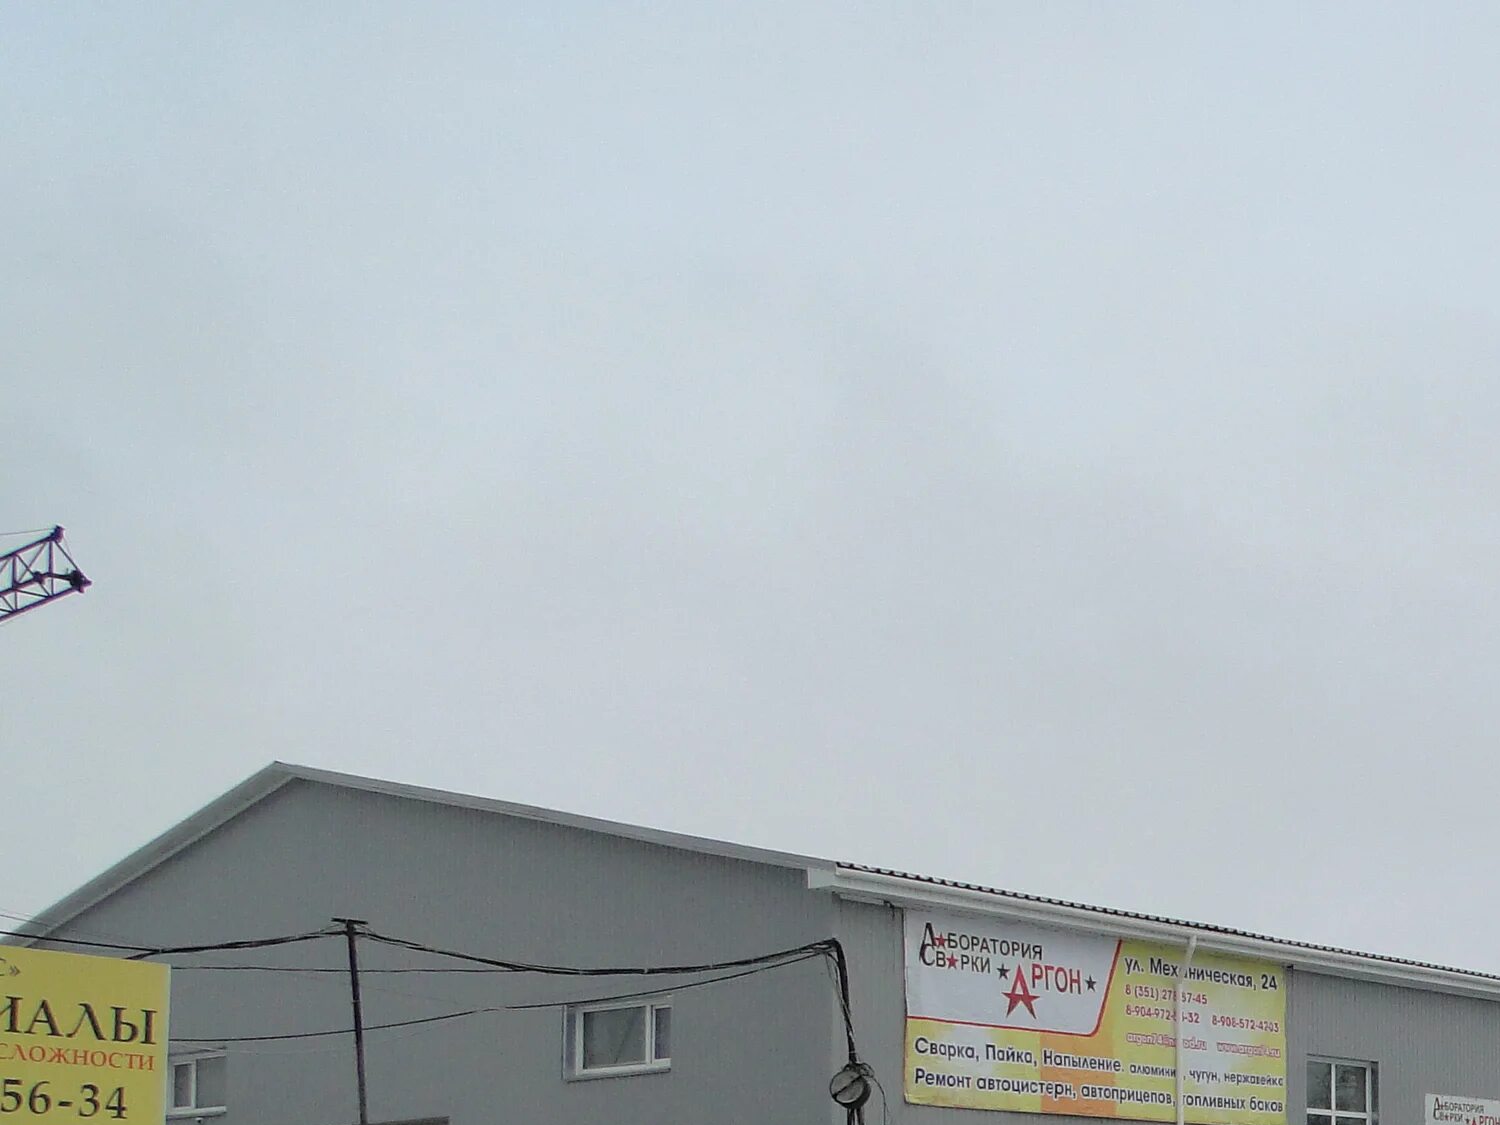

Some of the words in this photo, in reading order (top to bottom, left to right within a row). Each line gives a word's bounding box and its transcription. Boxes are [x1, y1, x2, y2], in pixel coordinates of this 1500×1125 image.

[1002, 963, 1081, 1019] АРГОН
[1125, 957, 1144, 975] ул.
[1150, 958, 1257, 990] Мехническая,
[1261, 974, 1278, 990] 24
[1125, 984, 1131, 995] 8
[1134, 985, 1159, 1002] (351)
[915, 1037, 979, 1061] Сварка,
[985, 1043, 1037, 1067] Пайка,
[1130, 1066, 1186, 1081] алюмини,
[1189, 1070, 1221, 1084] чугун,
[1224, 1072, 1283, 1087] нержавейка
[1, 1079, 127, 1119] 56-34
[915, 1068, 972, 1089] Ремонт
[977, 1076, 1077, 1099] автоцистерн,
[1081, 1085, 1176, 1108] автоприцепов,
[1249, 1096, 1283, 1112] баков
